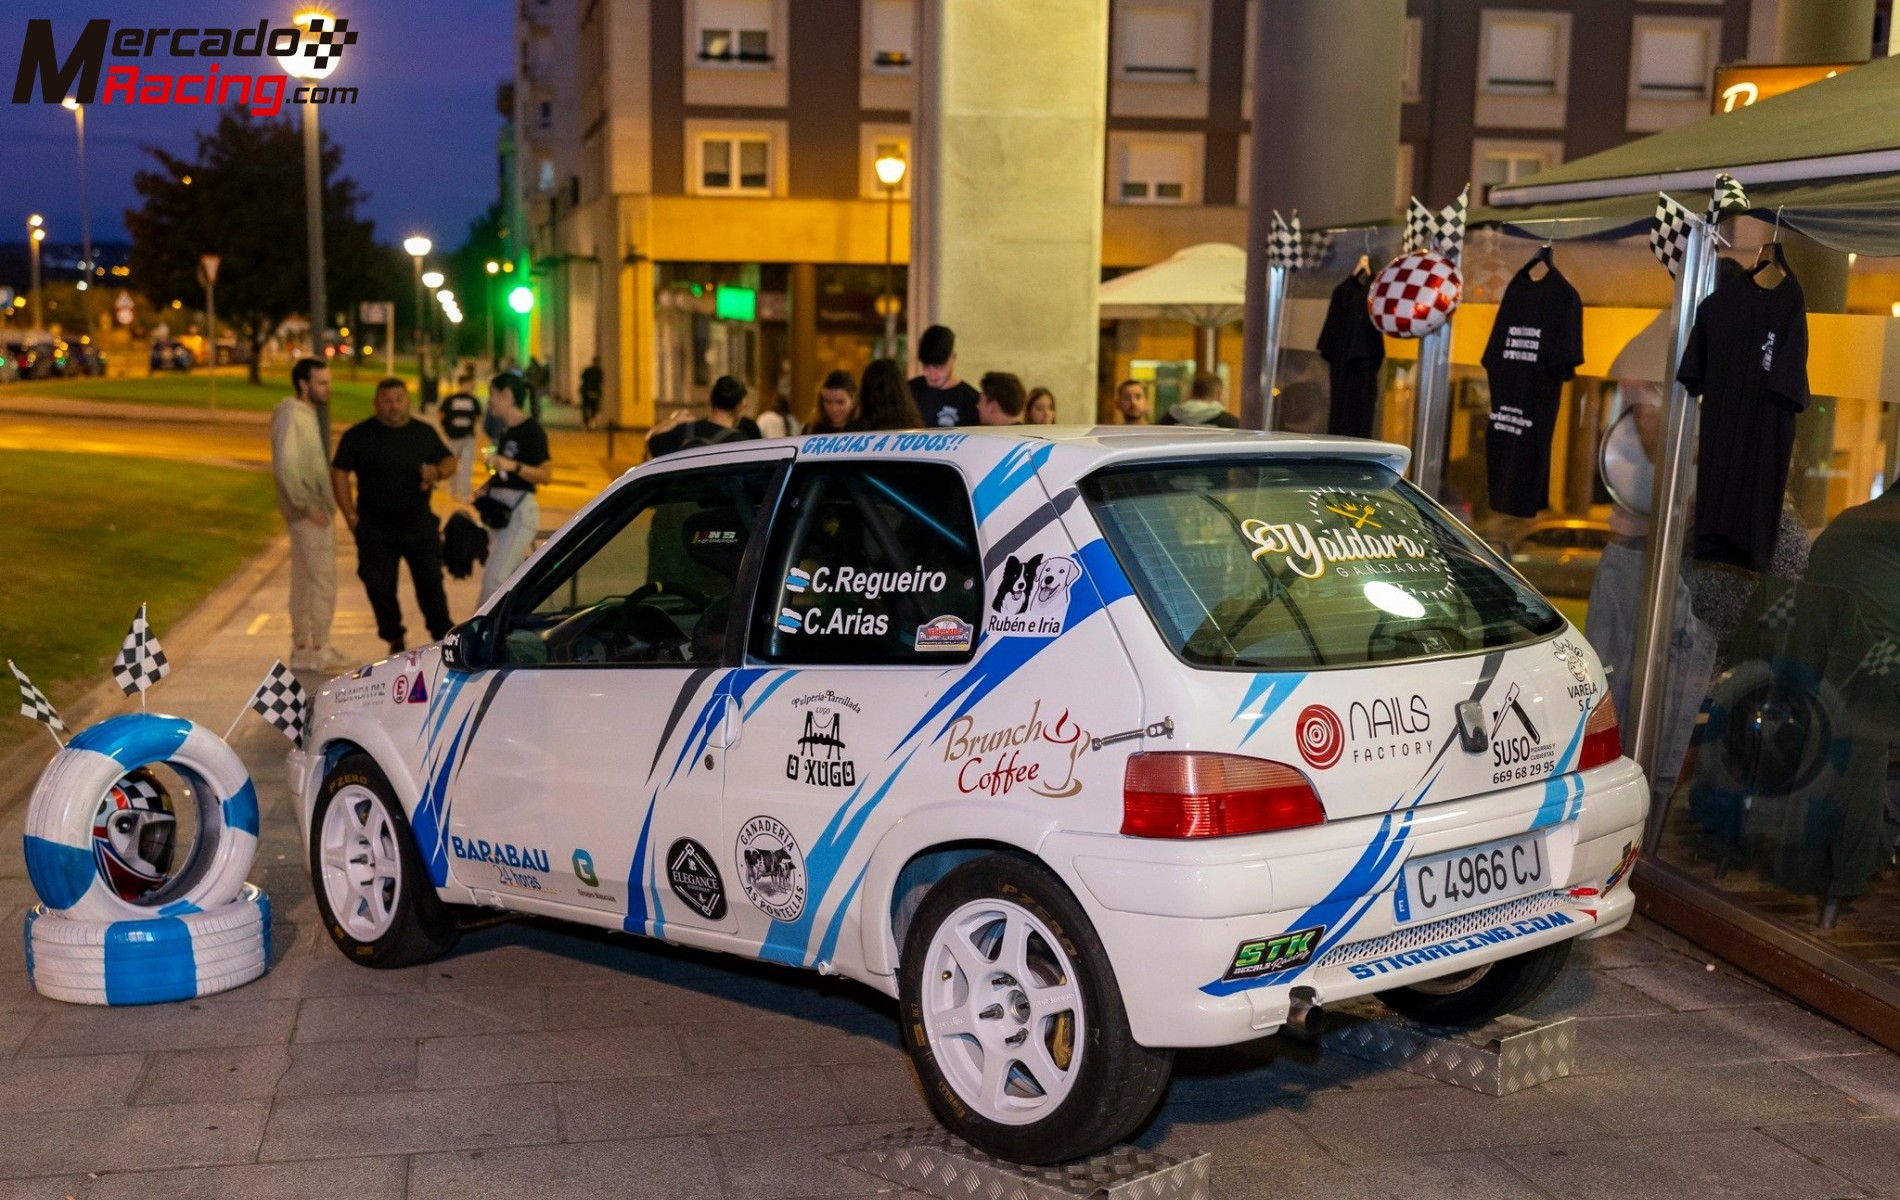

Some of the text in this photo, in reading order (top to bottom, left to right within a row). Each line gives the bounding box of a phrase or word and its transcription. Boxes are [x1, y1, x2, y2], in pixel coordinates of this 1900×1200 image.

[802, 434, 970, 455] GRACIAS A TODOS!!
[812, 565, 947, 600] C.Regueiro
[1336, 562, 1441, 578] GANDARAS
[804, 607, 889, 635] C.Arias
[988, 615, 1060, 633] Rubén e Iria
[1567, 682, 1598, 699] VARELA
[943, 698, 1043, 763] Brunch
[1350, 694, 1431, 741] NAILS
[1353, 740, 1433, 763] FACTORY
[1493, 735, 1530, 767] SUSO
[786, 754, 856, 787] O XUGO
[957, 750, 1040, 796] Coffee
[1493, 760, 1555, 784] 669 68 29 95
[451, 835, 551, 873] BARABAU
[492, 865, 542, 890] 24 horas
[672, 871, 719, 890] ELEGANCE
[1418, 839, 1542, 909] C 4966 CJ
[745, 885, 805, 918] AS PONTELLAS
[1398, 900, 1405, 912] E
[1235, 930, 1316, 967] STK
[1347, 911, 1575, 980] STKRACING.COM
[1234, 950, 1311, 975] DECALS Racing
